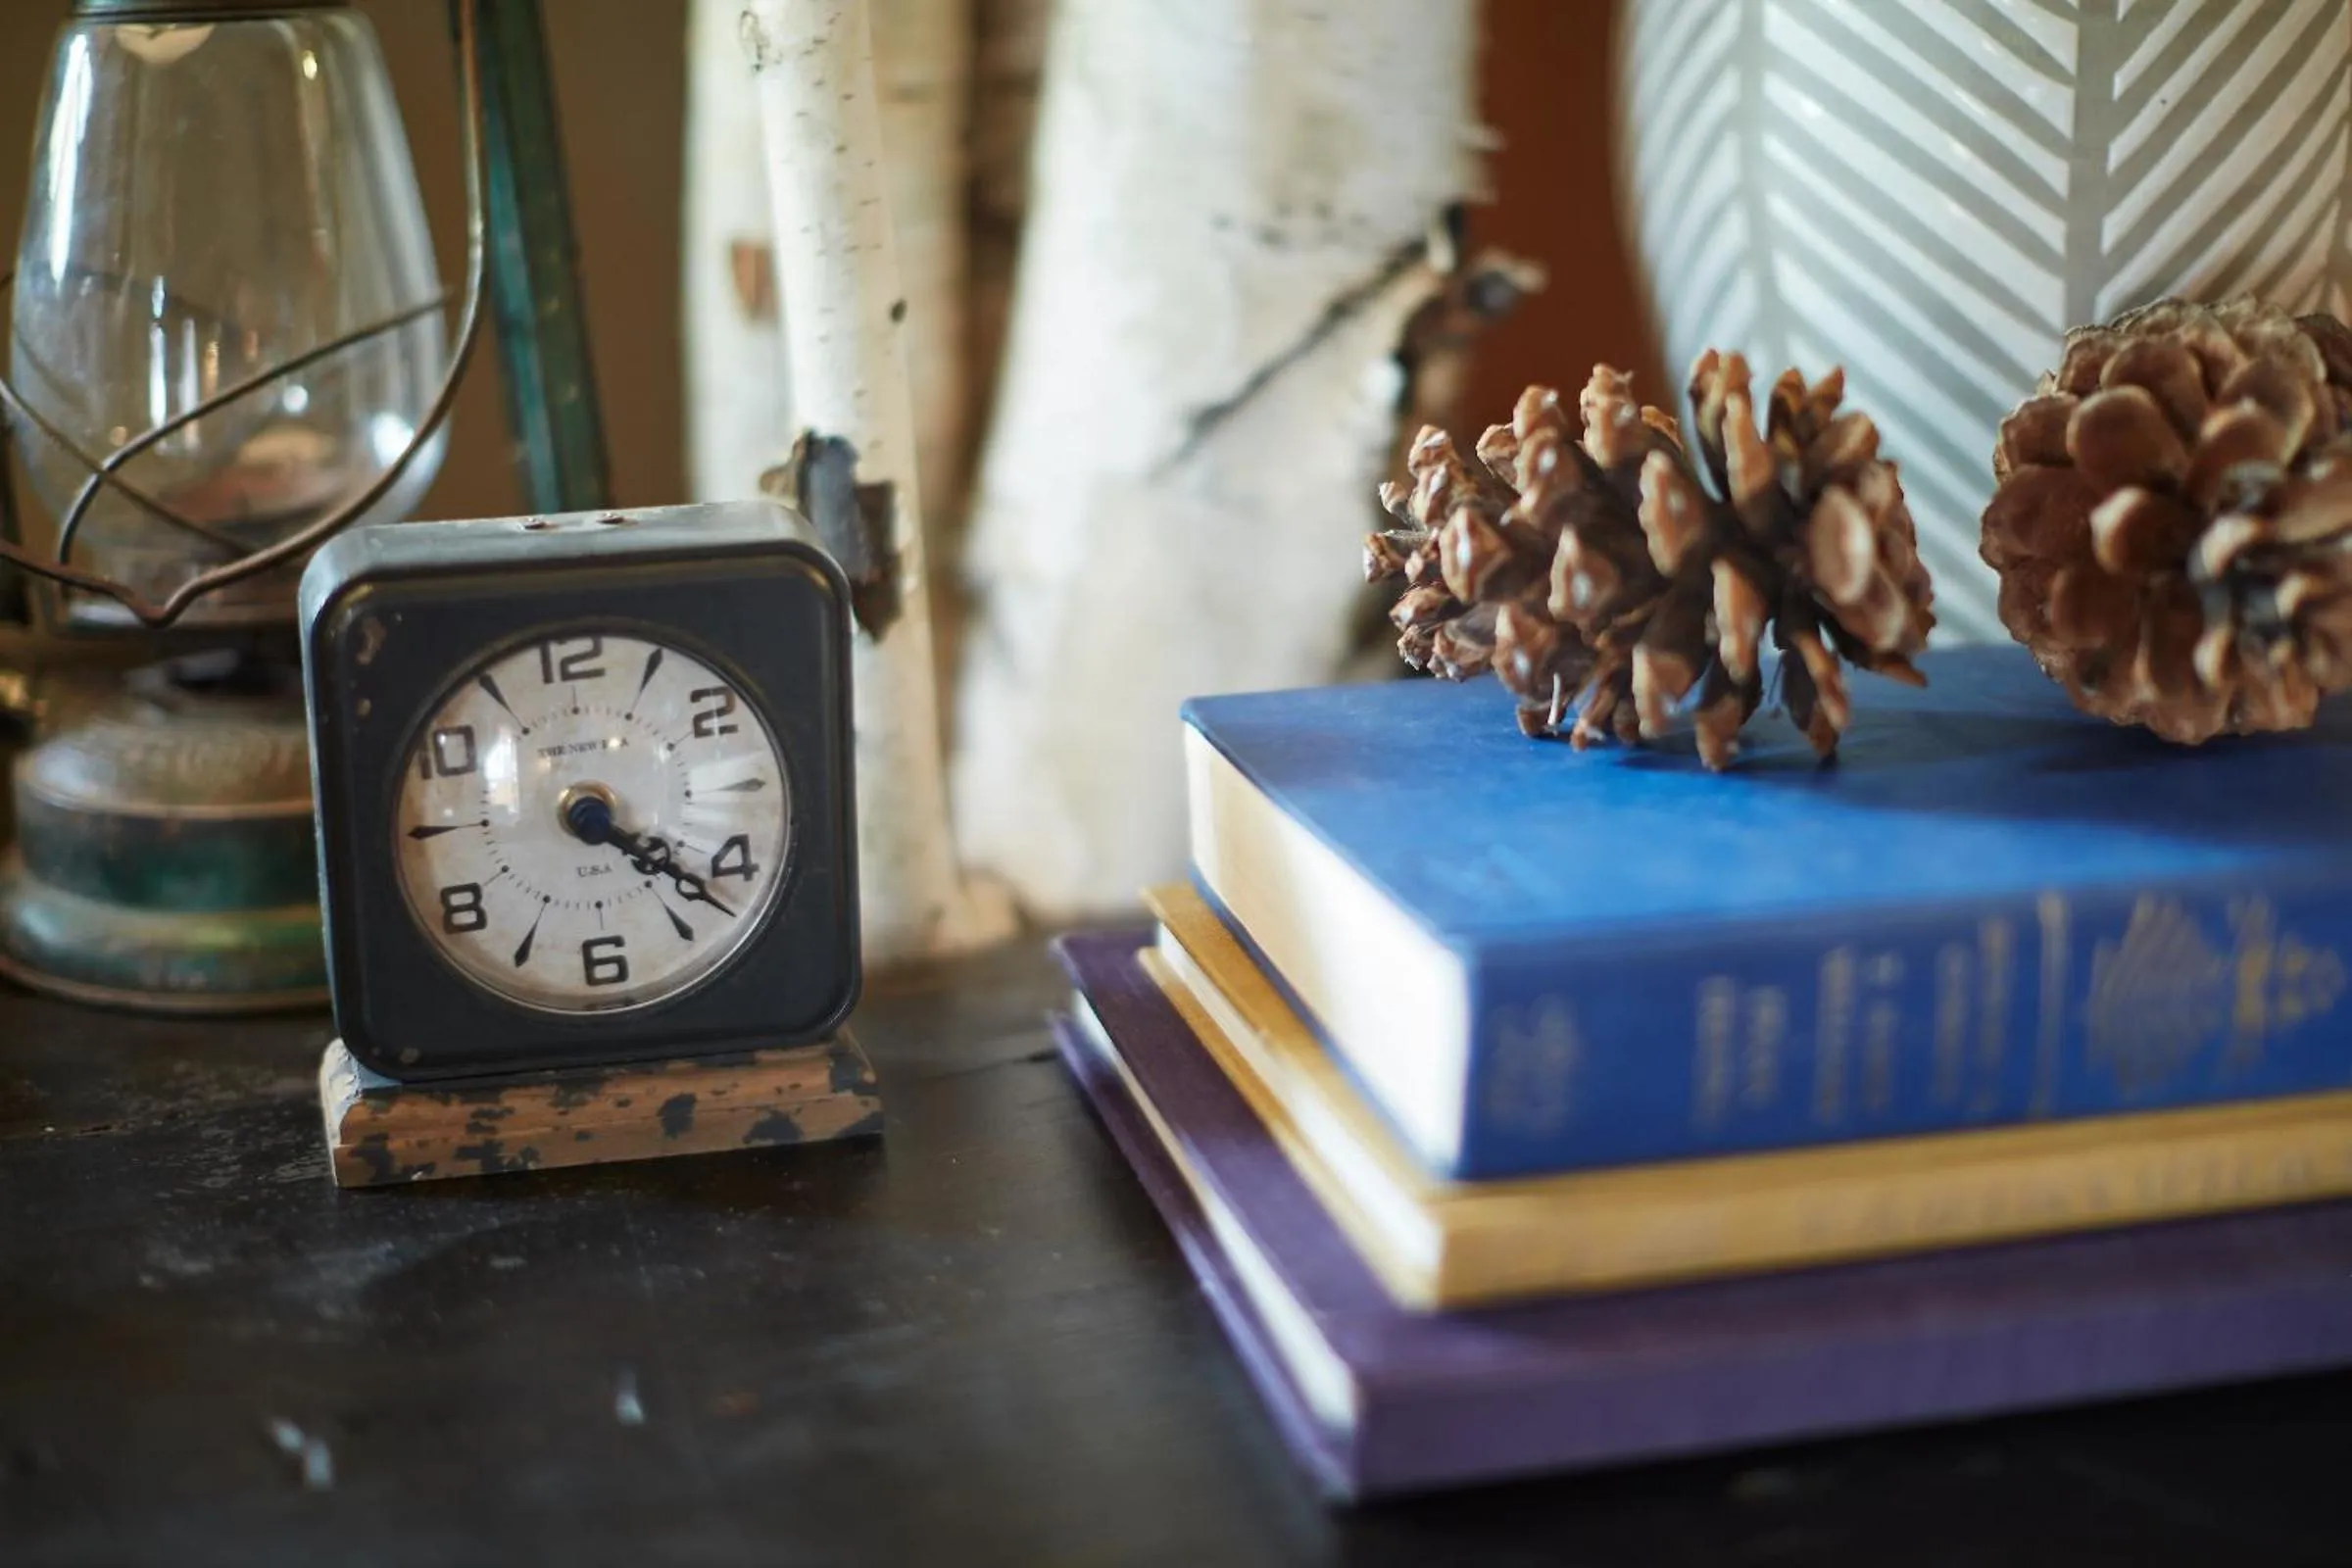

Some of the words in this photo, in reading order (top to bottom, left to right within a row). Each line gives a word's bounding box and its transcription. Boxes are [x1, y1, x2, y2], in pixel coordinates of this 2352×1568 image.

[539, 635, 606, 684] 12
[690, 686, 739, 738] 2
[418, 724, 477, 780] 10
[537, 745, 565, 759] THE
[567, 740, 597, 755] NEW
[710, 834, 760, 882] 4
[440, 882, 488, 935] 8
[581, 935, 630, 986] 6
